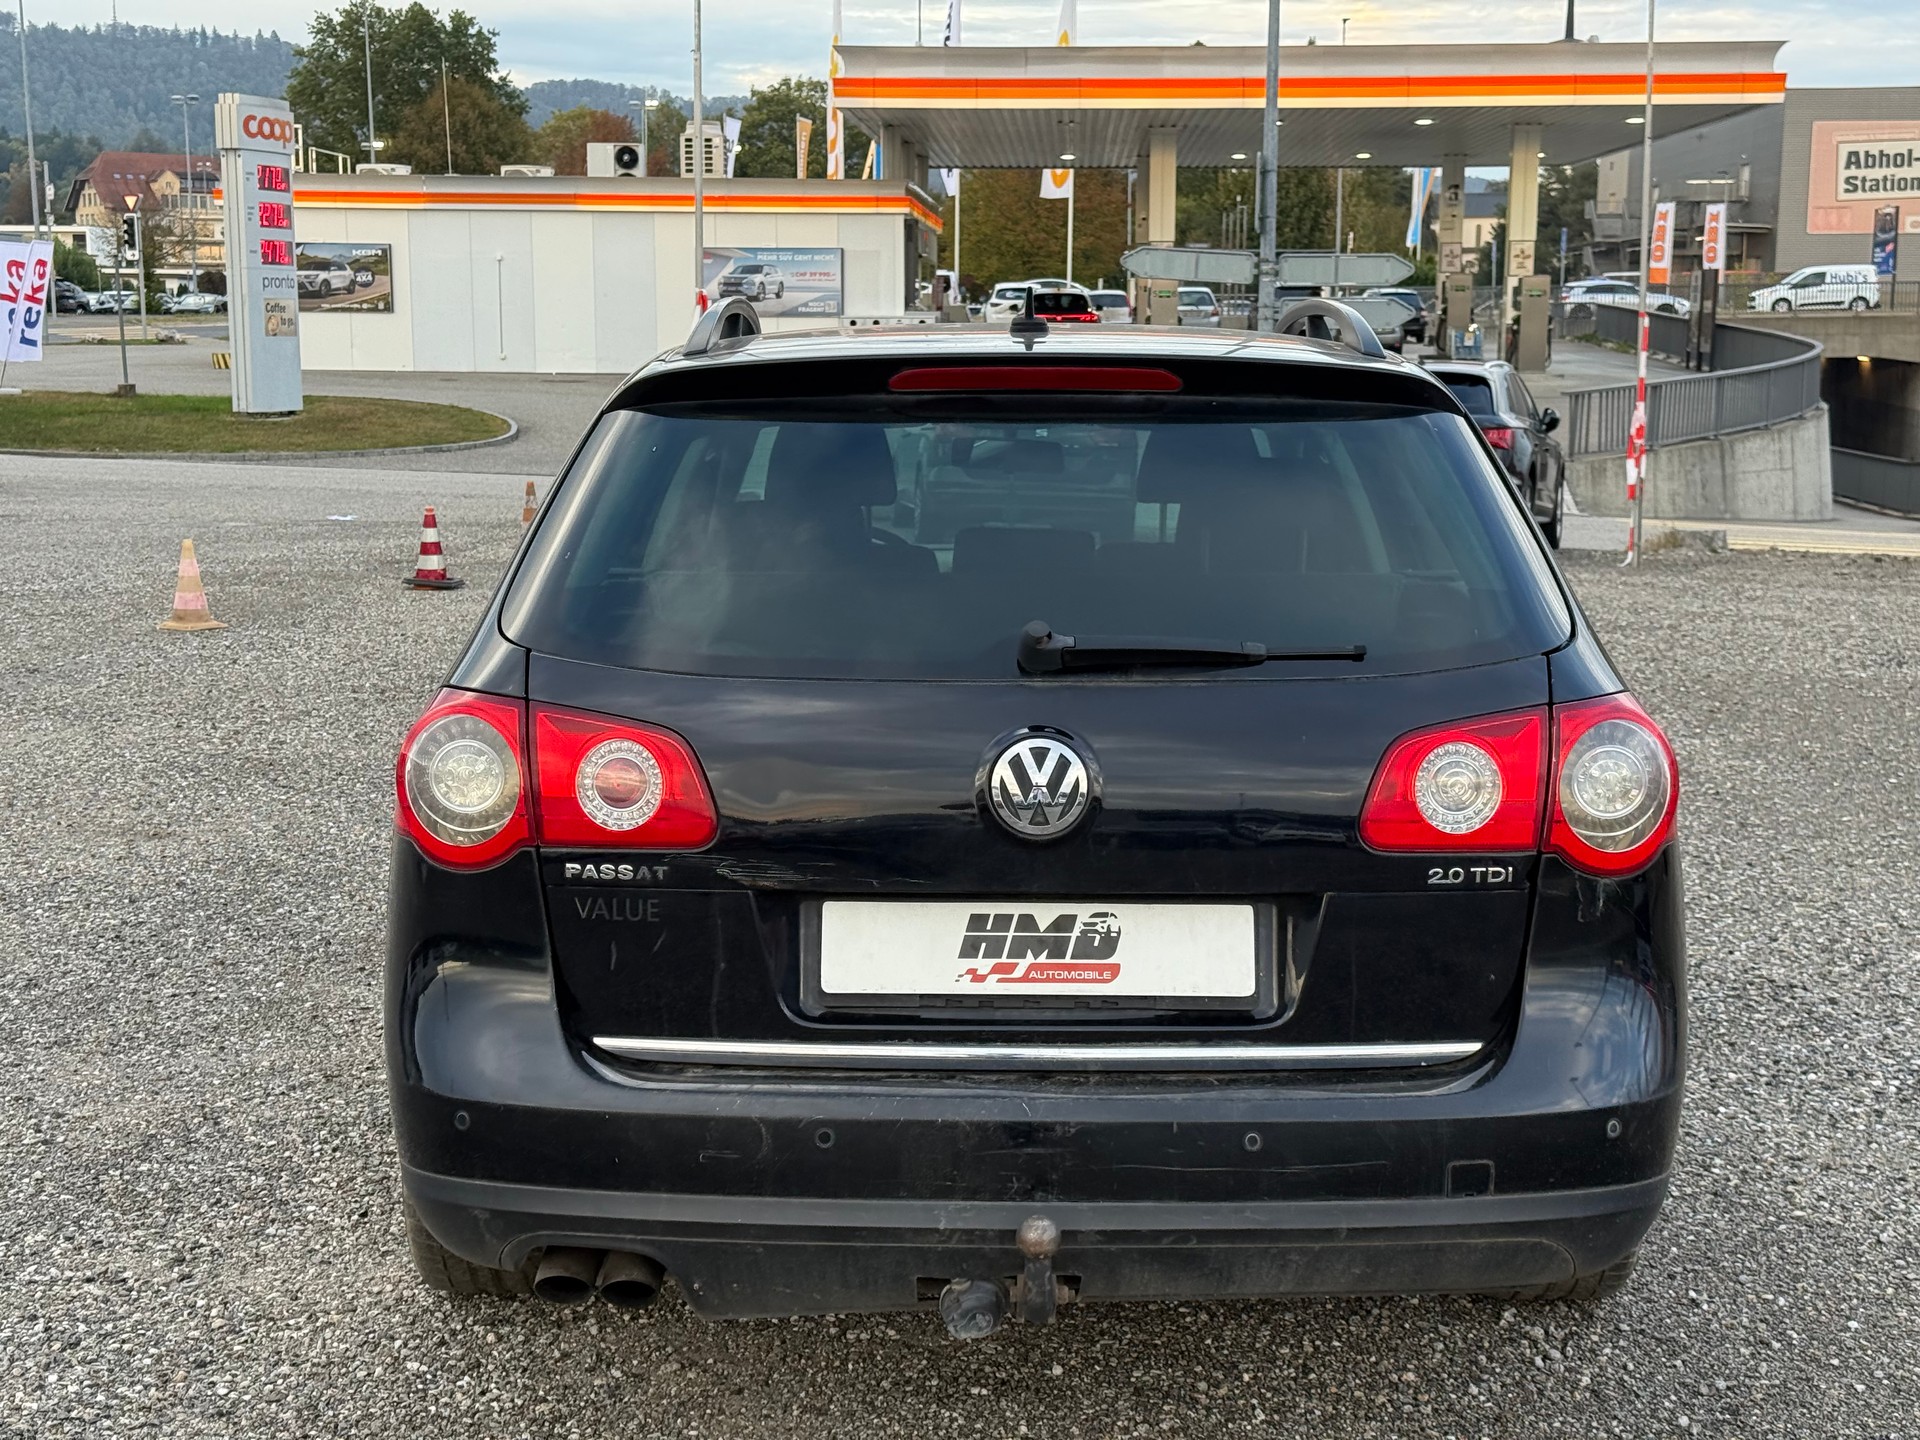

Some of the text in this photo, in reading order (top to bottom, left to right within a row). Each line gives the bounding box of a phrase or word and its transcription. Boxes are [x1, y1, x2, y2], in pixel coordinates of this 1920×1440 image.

[242, 114, 293, 149] coop
[1843, 174, 1920, 193] Station
[262, 275, 296, 292] pronto
[19, 258, 48, 348] reka
[265, 302, 287, 314] Coffee
[564, 863, 669, 881] PASSAT
[1470, 866, 1513, 884] TDI
[573, 896, 661, 922] VALUE
[957, 912, 1122, 961] HMD
[1028, 971, 1112, 980] AUTOMOBILE
